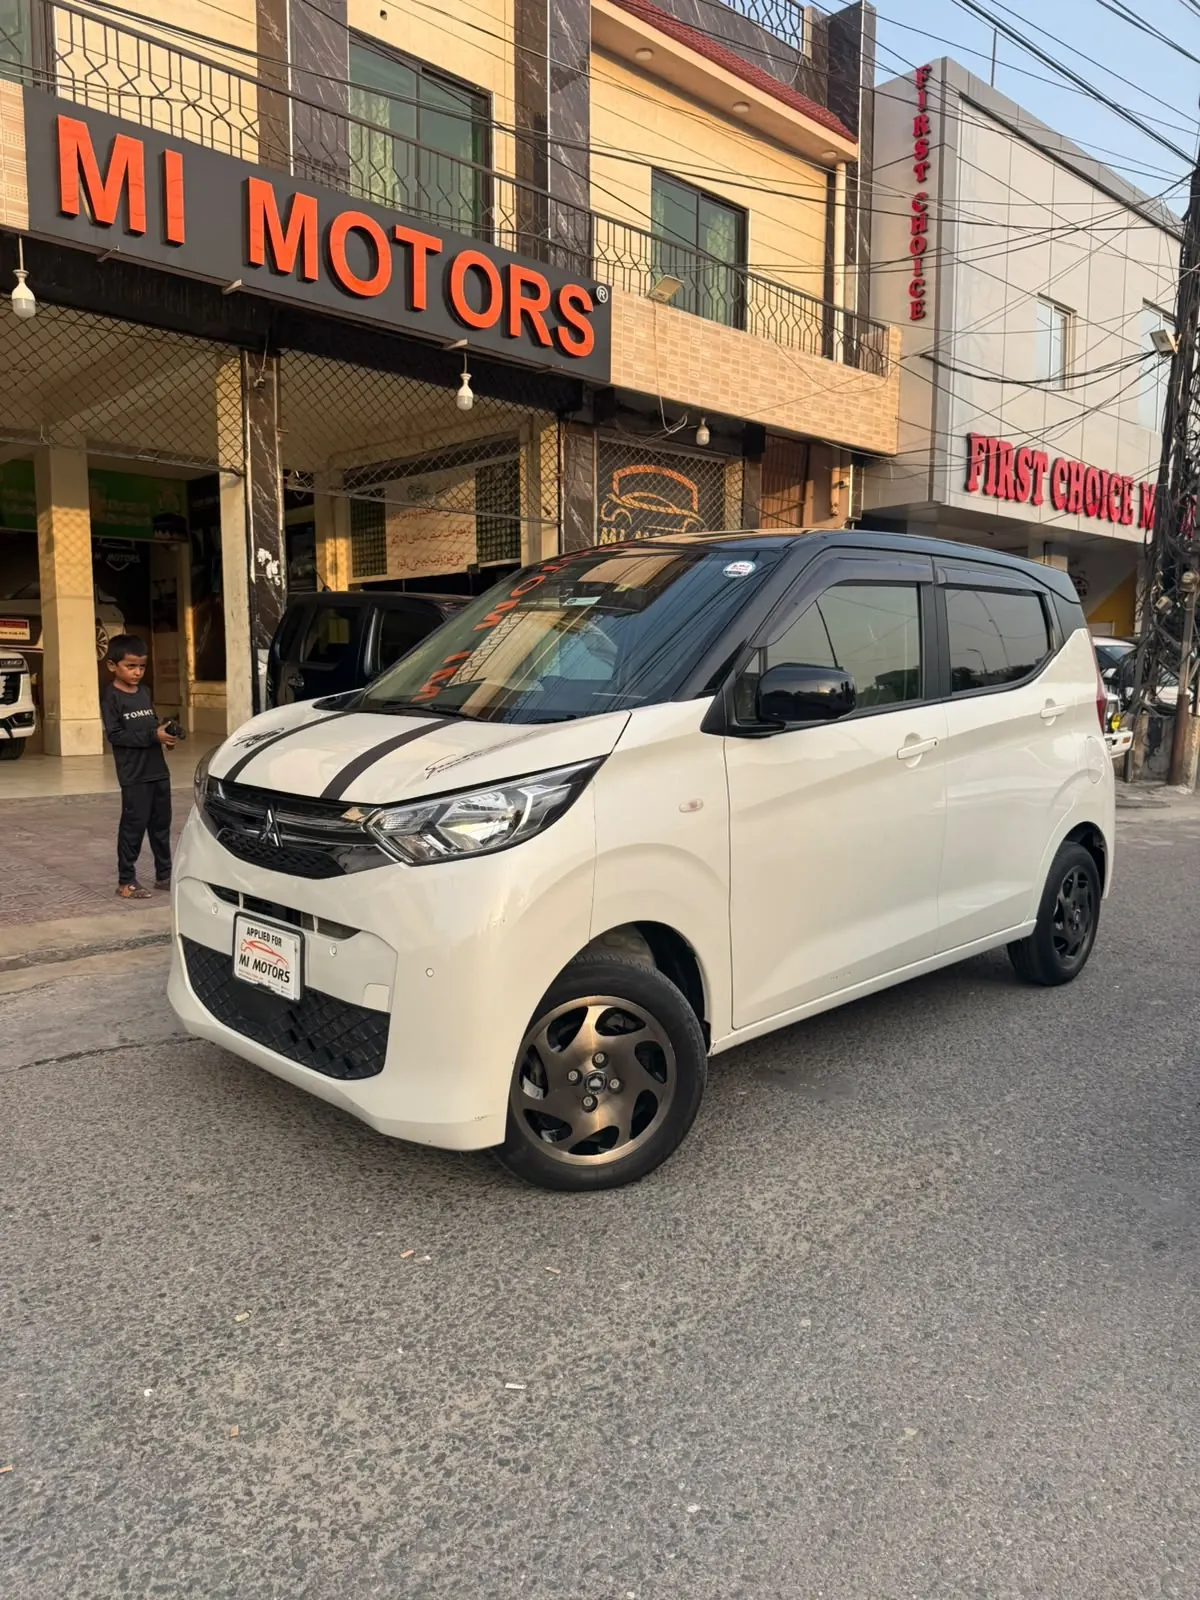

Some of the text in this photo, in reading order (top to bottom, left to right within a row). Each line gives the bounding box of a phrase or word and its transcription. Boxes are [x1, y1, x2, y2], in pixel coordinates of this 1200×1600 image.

[56, 113, 186, 245] MI
[247, 176, 596, 358] MOTORS
[908, 64, 932, 321] FIRST CHOICE
[967, 432, 1048, 506] FIRST
[1051, 456, 1134, 526] CHOICE
[239, 953, 249, 967] MI
[252, 958, 290, 983] MOTORS
[246, 927, 282, 948] APPLIED FOR
